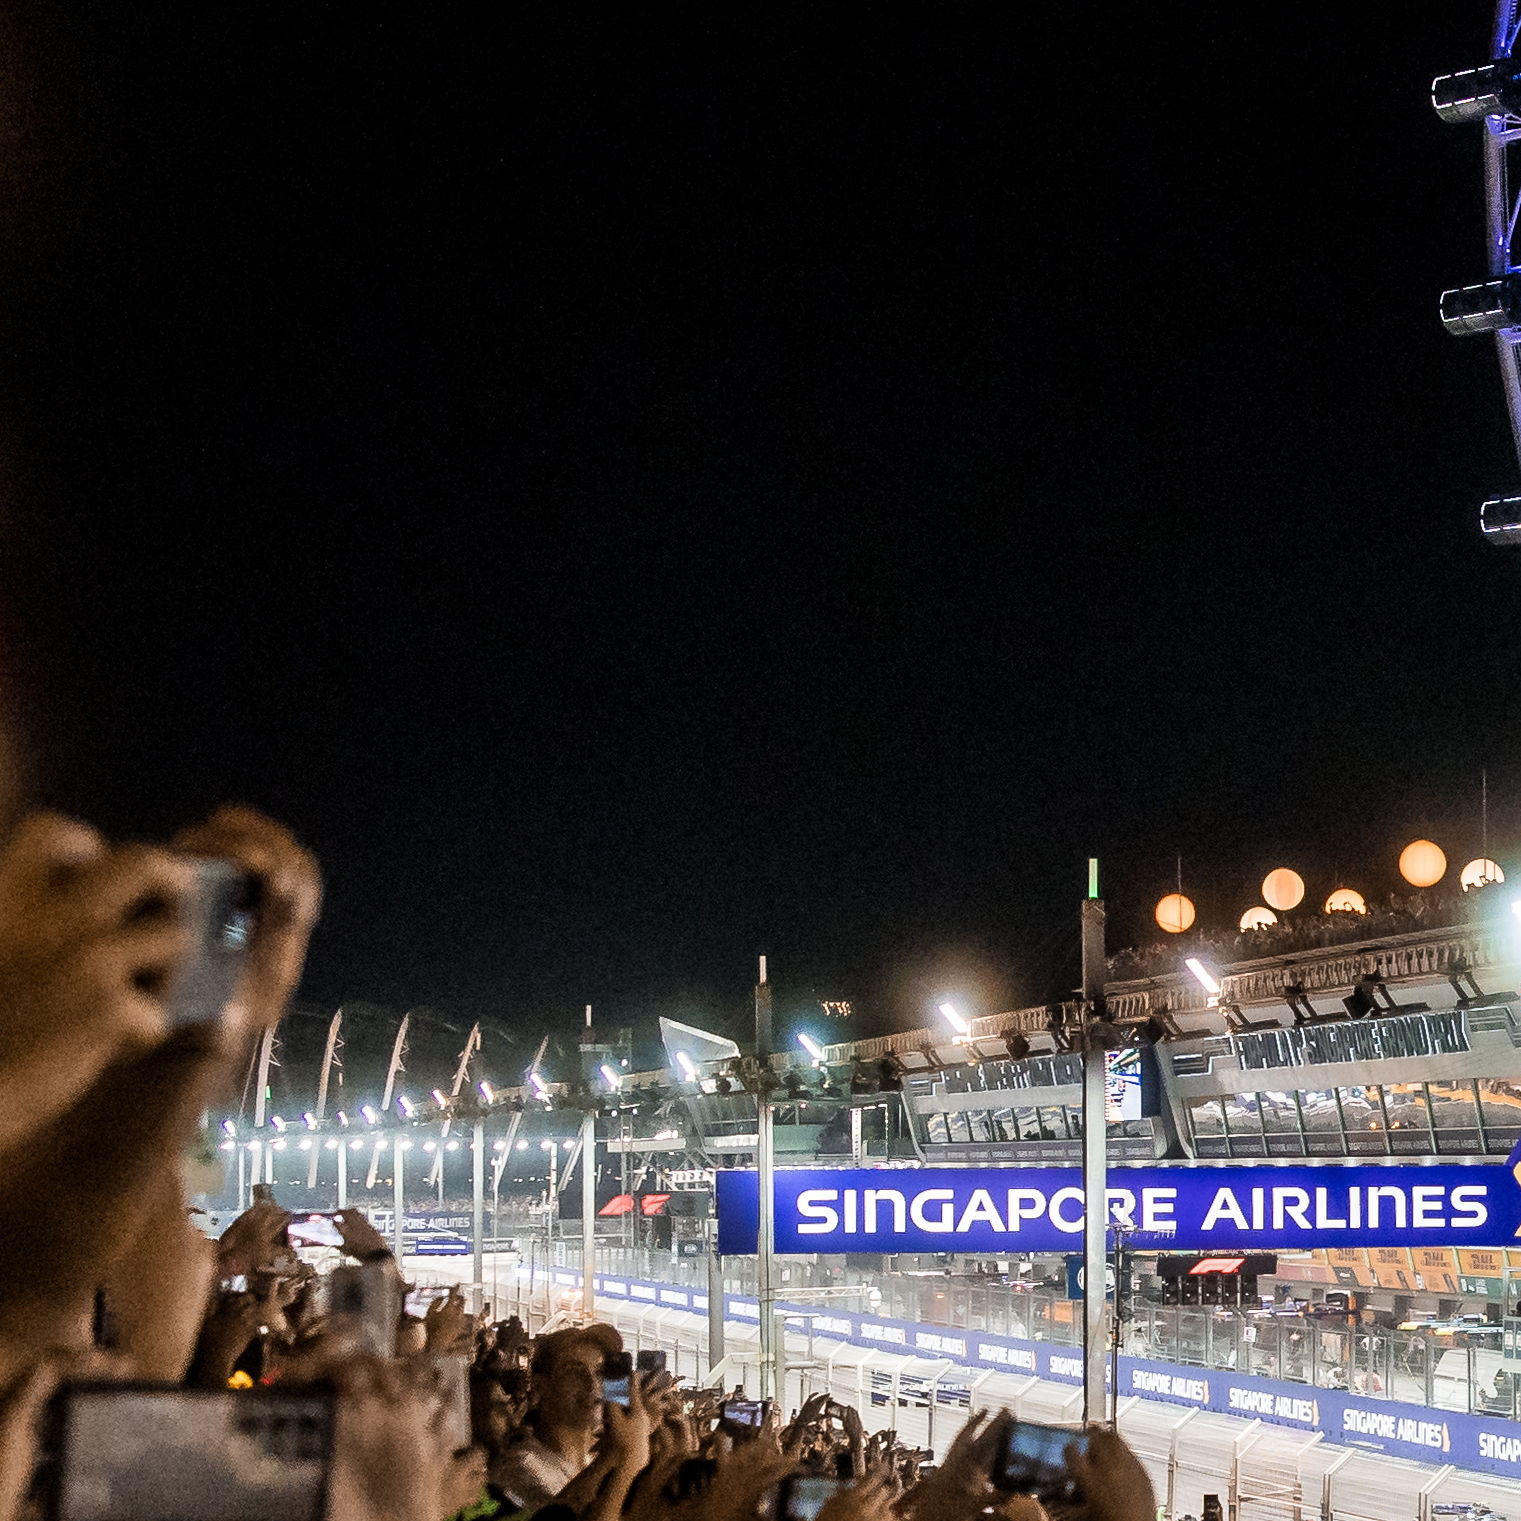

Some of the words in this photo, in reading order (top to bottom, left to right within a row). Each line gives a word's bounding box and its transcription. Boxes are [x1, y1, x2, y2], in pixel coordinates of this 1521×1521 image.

[428, 1215, 470, 1230] AIRLINES
[796, 1187, 1177, 1234] SINGAPORE
[1201, 1185, 1488, 1231] AIRLINES
[1229, 1387, 1274, 1416] SINGAPORE
[1274, 1394, 1313, 1422] AIRLINES
[1343, 1409, 1396, 1439] SINGAPORE
[1397, 1416, 1442, 1449] AIRLINES
